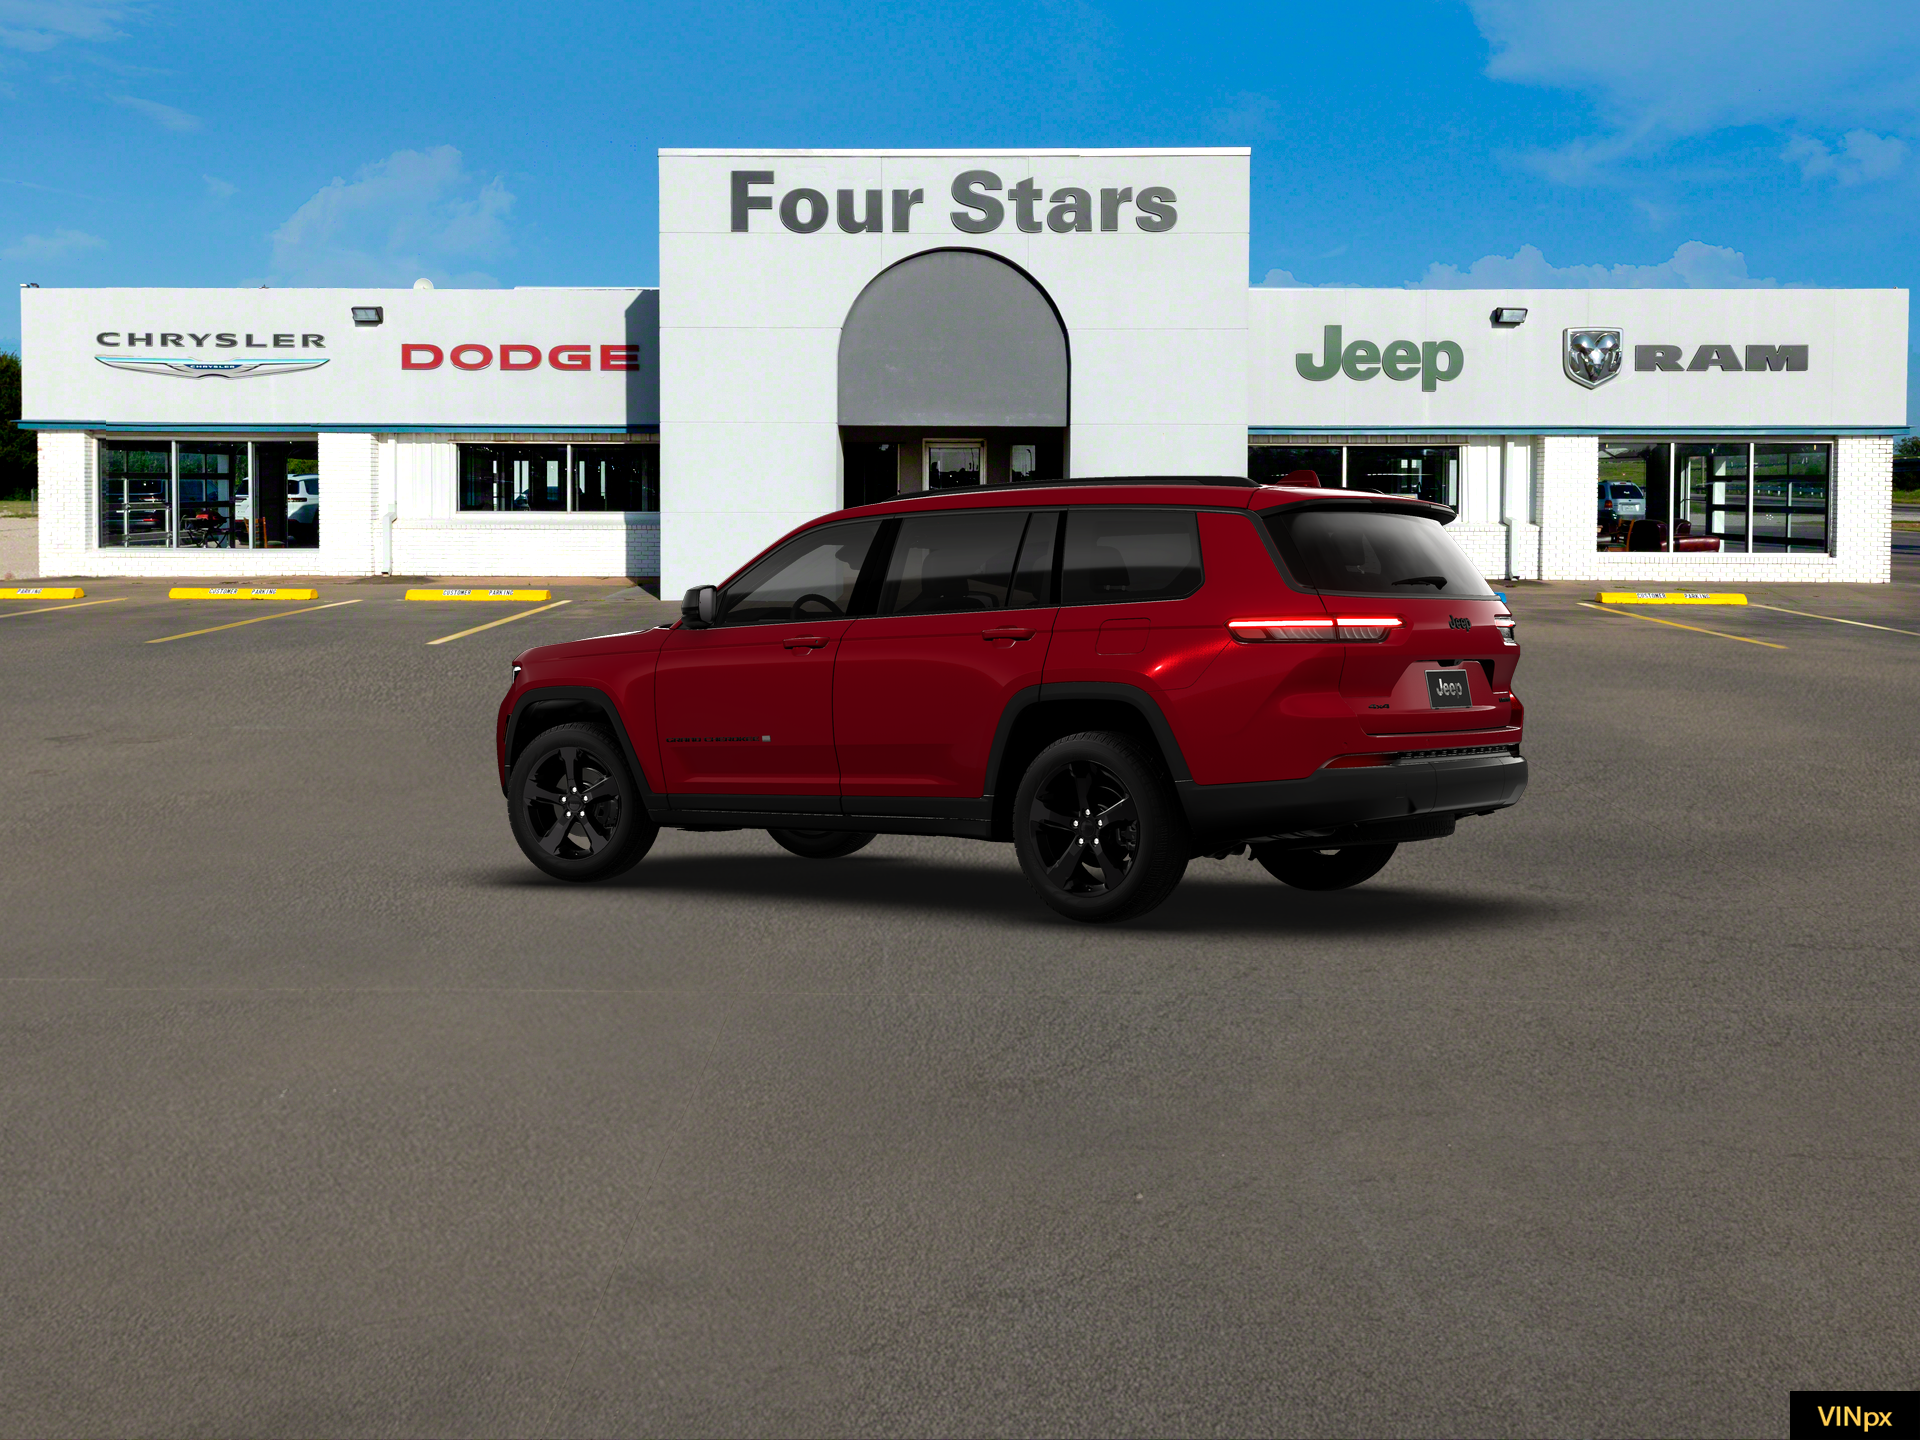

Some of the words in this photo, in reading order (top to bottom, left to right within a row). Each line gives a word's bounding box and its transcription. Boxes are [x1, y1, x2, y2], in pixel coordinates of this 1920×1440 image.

[730, 169, 925, 234] Four
[949, 169, 1179, 234] Stars
[96, 332, 326, 348] CHRYSLER
[401, 343, 640, 371] DODGE
[1295, 324, 1465, 393] Jeep
[1634, 344, 1810, 372] RAM
[1448, 615, 1472, 632] Jeep
[1436, 678, 1463, 699] Jeep
